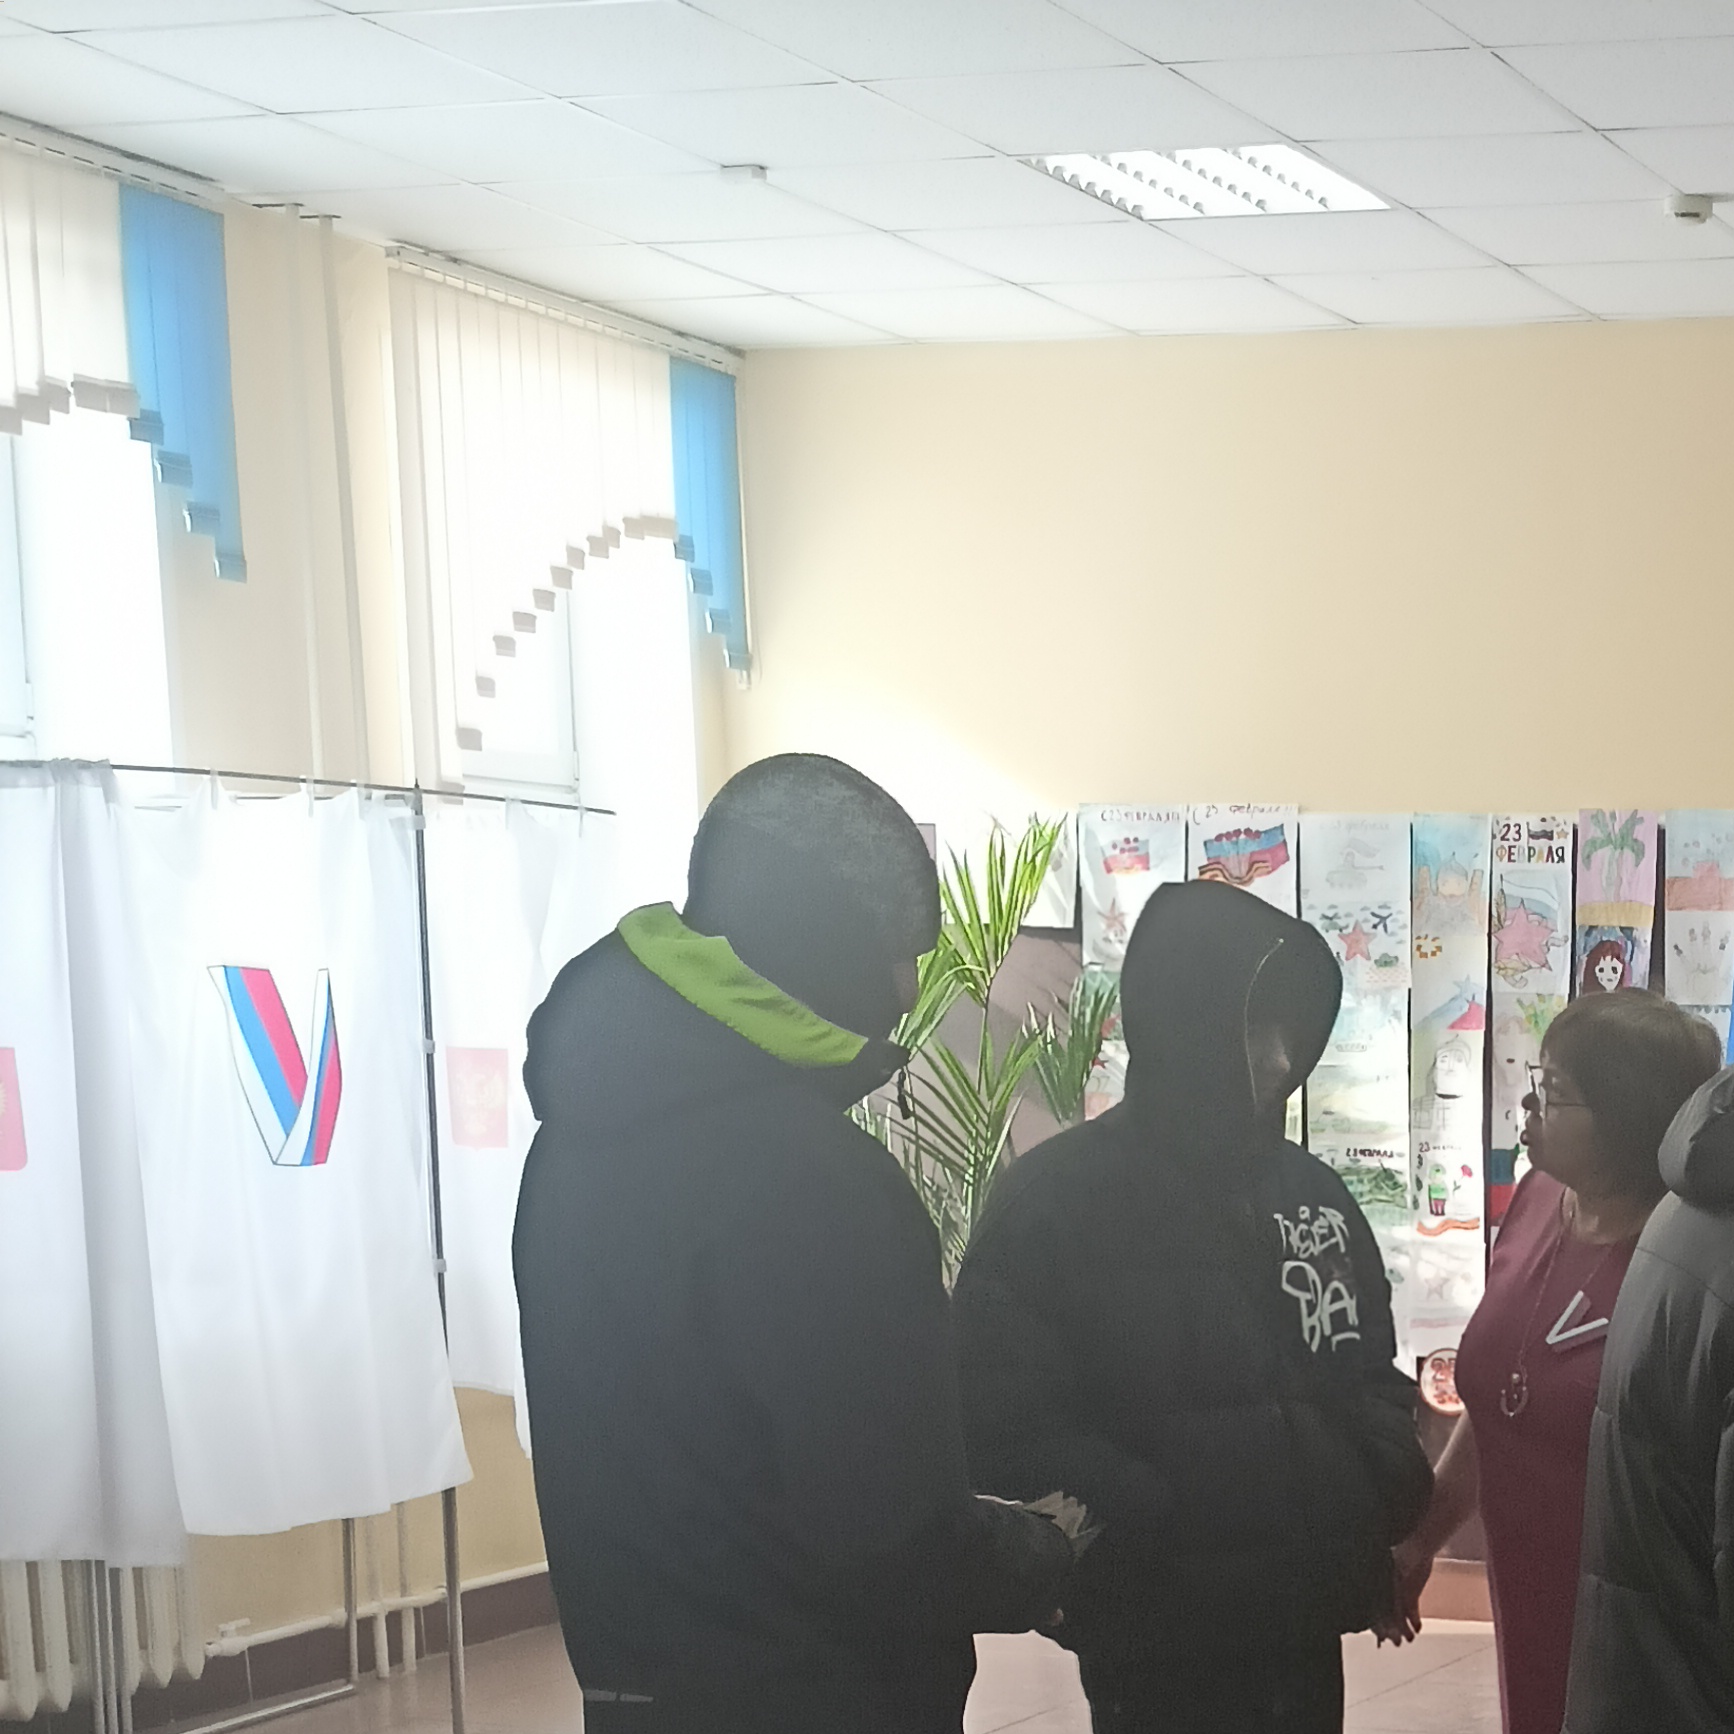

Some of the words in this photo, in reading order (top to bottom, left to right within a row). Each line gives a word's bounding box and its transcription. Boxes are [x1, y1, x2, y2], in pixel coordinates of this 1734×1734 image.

[1500, 823, 1522, 842] 23
[1496, 845, 1565, 863] ФЕВРАЛЯ
[1418, 1140, 1431, 1153] 23
